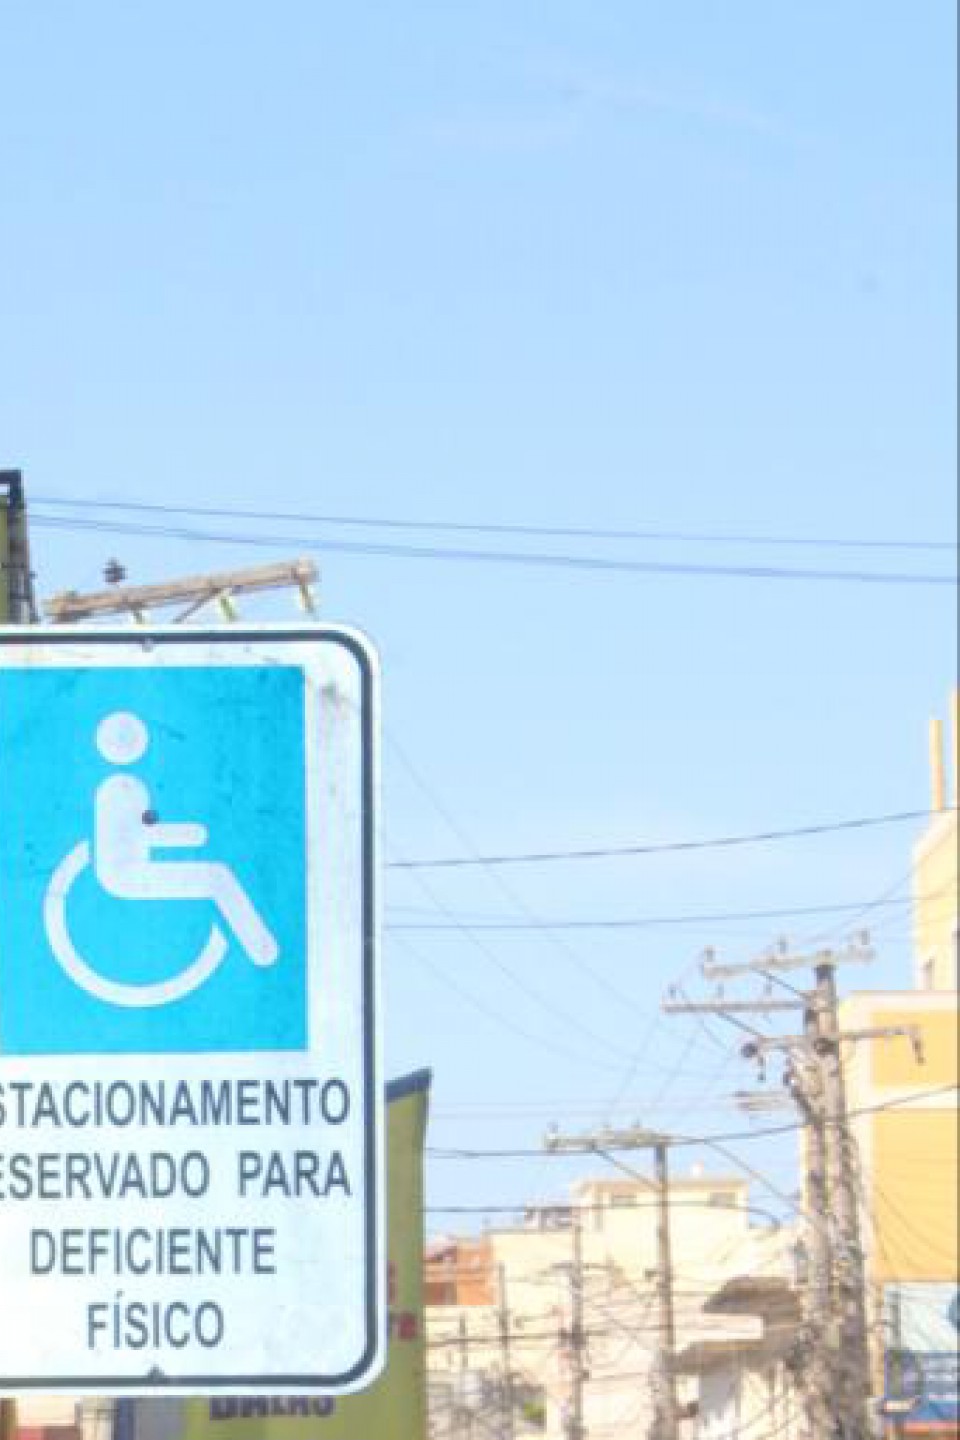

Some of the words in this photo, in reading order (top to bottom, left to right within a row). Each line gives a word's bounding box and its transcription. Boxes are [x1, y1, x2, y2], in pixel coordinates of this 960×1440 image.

[239, 1150, 352, 1197] PARA
[30, 1228, 276, 1275] DEFICIENTE
[87, 1291, 224, 1349] FÍSICO
